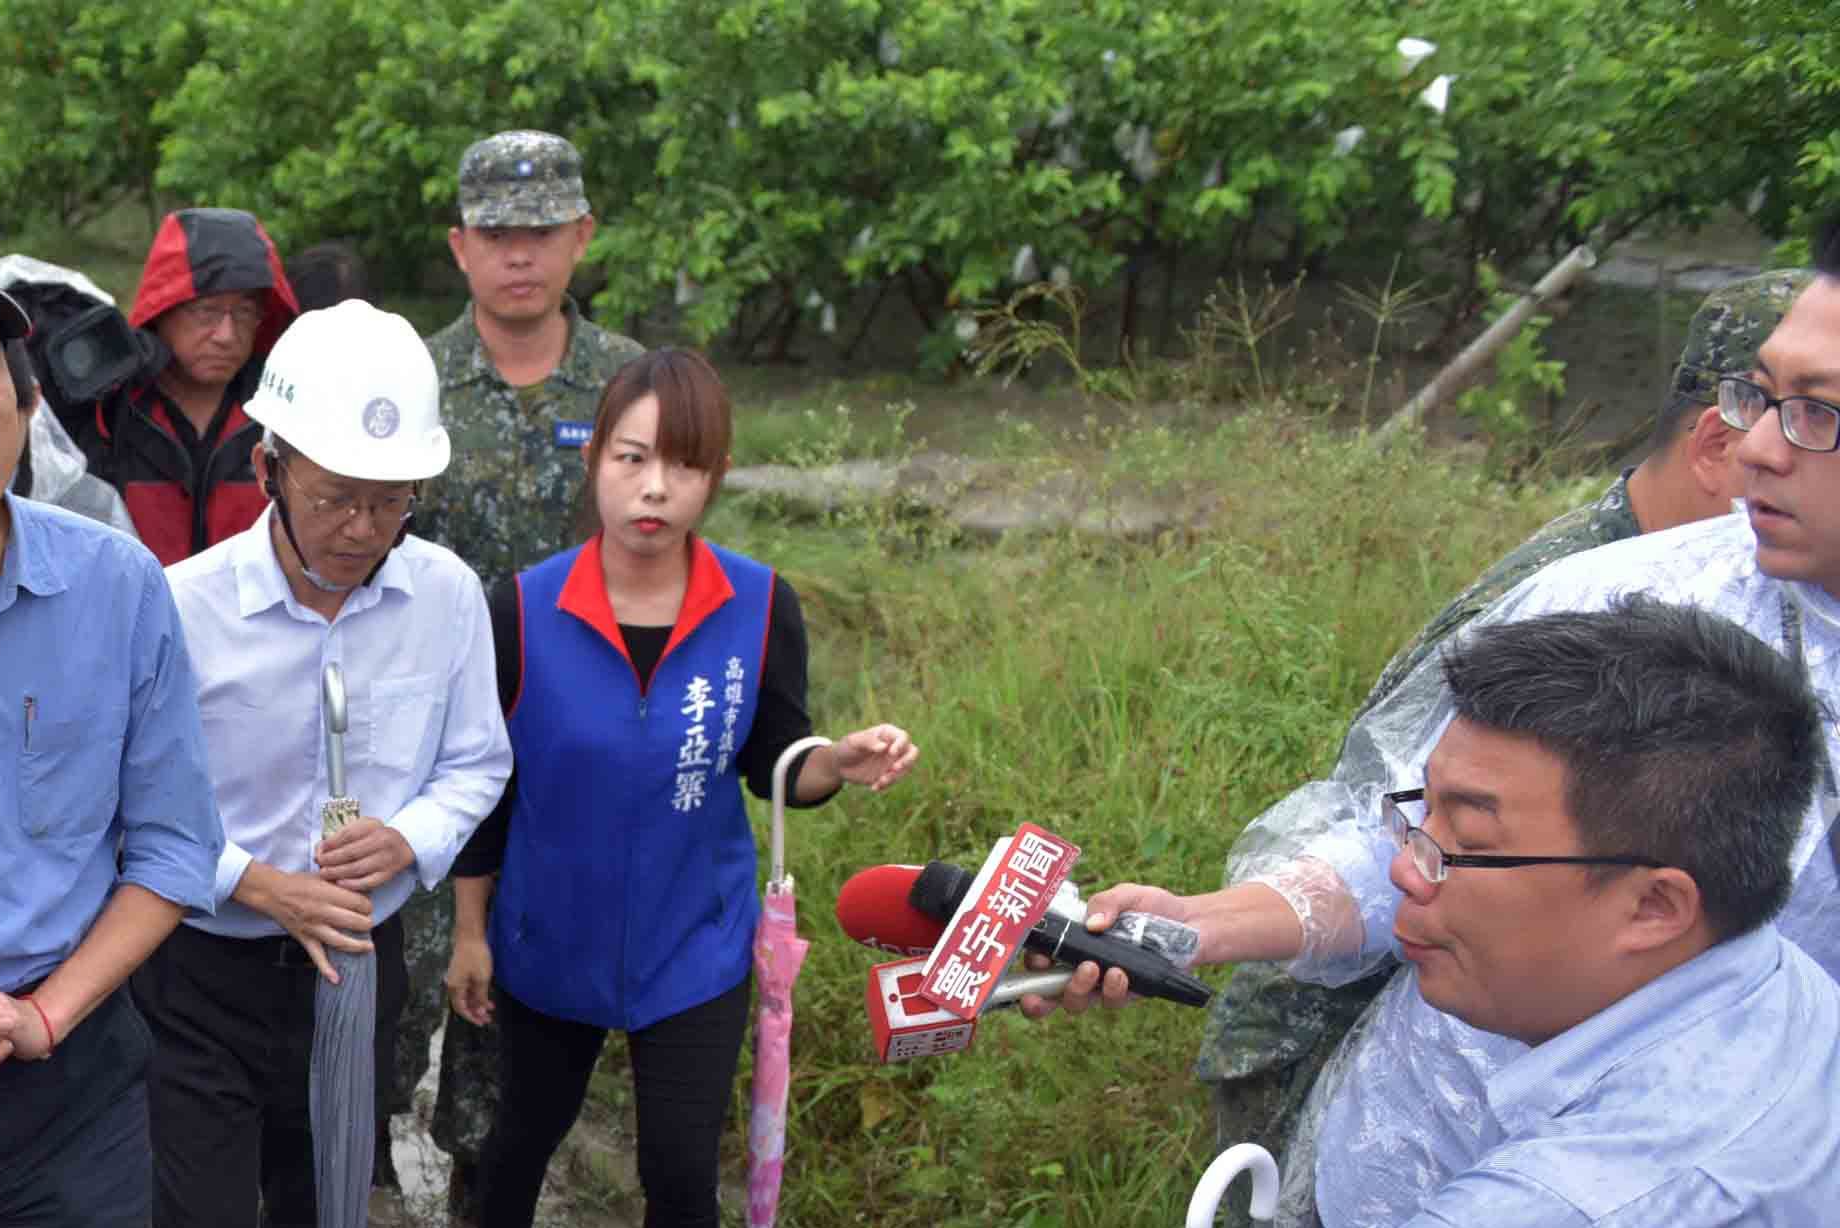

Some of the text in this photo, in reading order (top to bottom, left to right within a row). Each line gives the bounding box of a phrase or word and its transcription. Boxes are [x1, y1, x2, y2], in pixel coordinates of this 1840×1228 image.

[672, 675, 716, 812] 李亞築
[716, 656, 745, 776] 高雄市議員
[931, 831, 1064, 1008] 寰宇新聞
